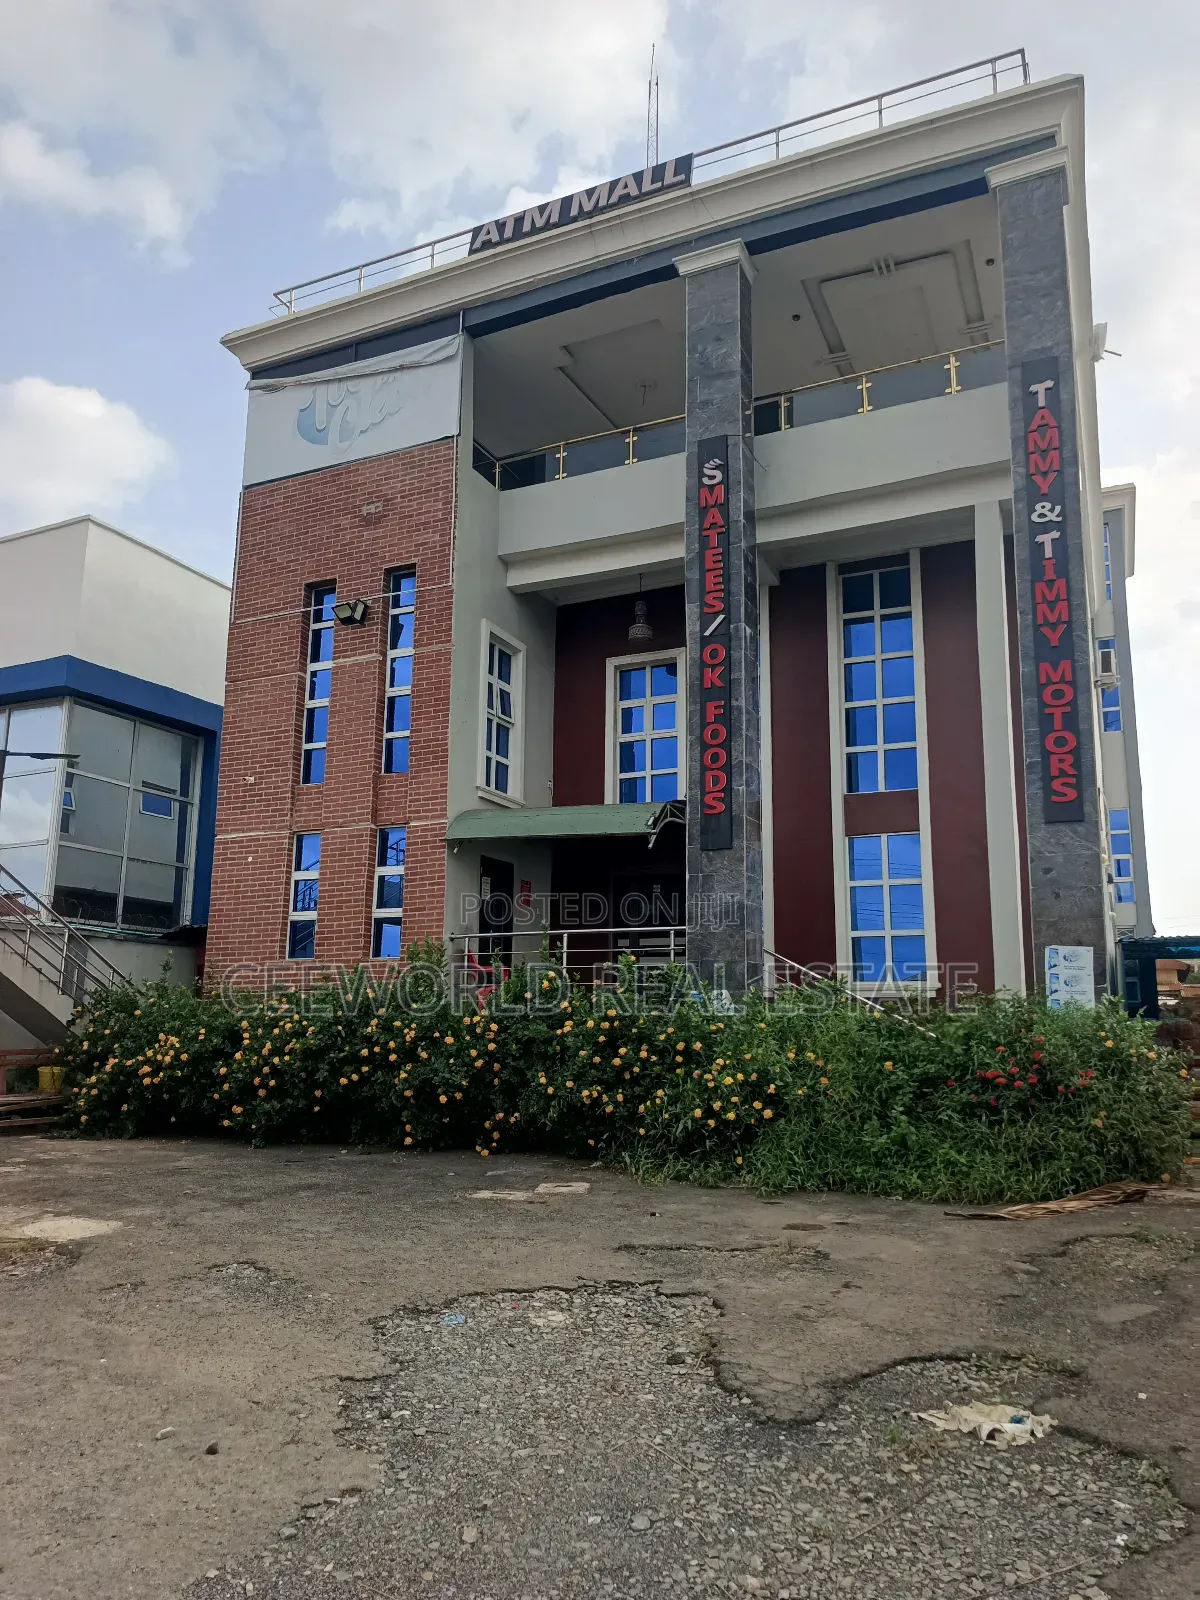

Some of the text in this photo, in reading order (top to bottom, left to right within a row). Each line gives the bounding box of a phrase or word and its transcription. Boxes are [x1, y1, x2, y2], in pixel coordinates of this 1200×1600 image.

[471, 158, 686, 250] ATM MALL
[1028, 379, 1078, 803] TAMMY & TIMMY MOTORS
[702, 700, 727, 816] FOODS
